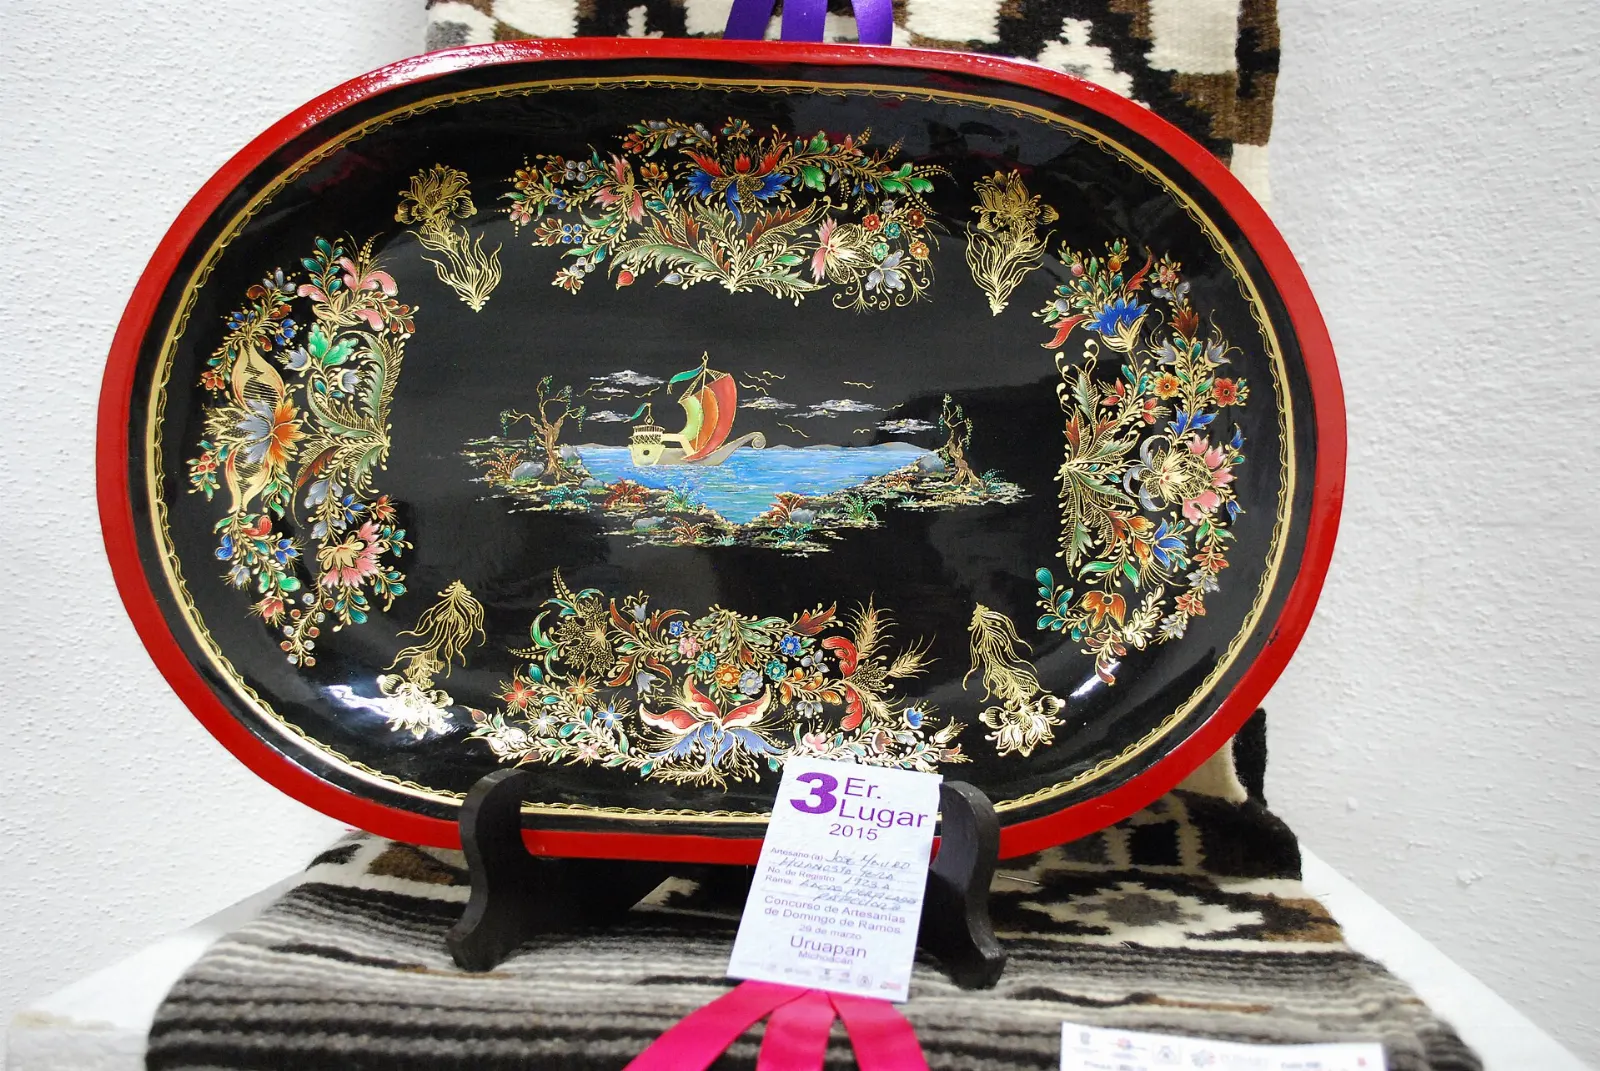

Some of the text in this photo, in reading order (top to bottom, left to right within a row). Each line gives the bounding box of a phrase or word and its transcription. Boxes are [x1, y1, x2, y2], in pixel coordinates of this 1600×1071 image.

[790, 772, 881, 814] 3 Er.
[839, 799, 928, 828] Lugar
[829, 823, 878, 841] 2015
[770, 847, 809, 859] Artesano
[799, 871, 835, 881] Registro
[764, 895, 821, 911] Concurso
[824, 902, 839, 914] de
[764, 907, 779, 916] de
[783, 909, 836, 925] Domingo
[839, 916, 855, 927] de
[815, 926, 828, 935] de
[830, 930, 862, 940] marzo
[790, 935, 867, 959] Uruapan
